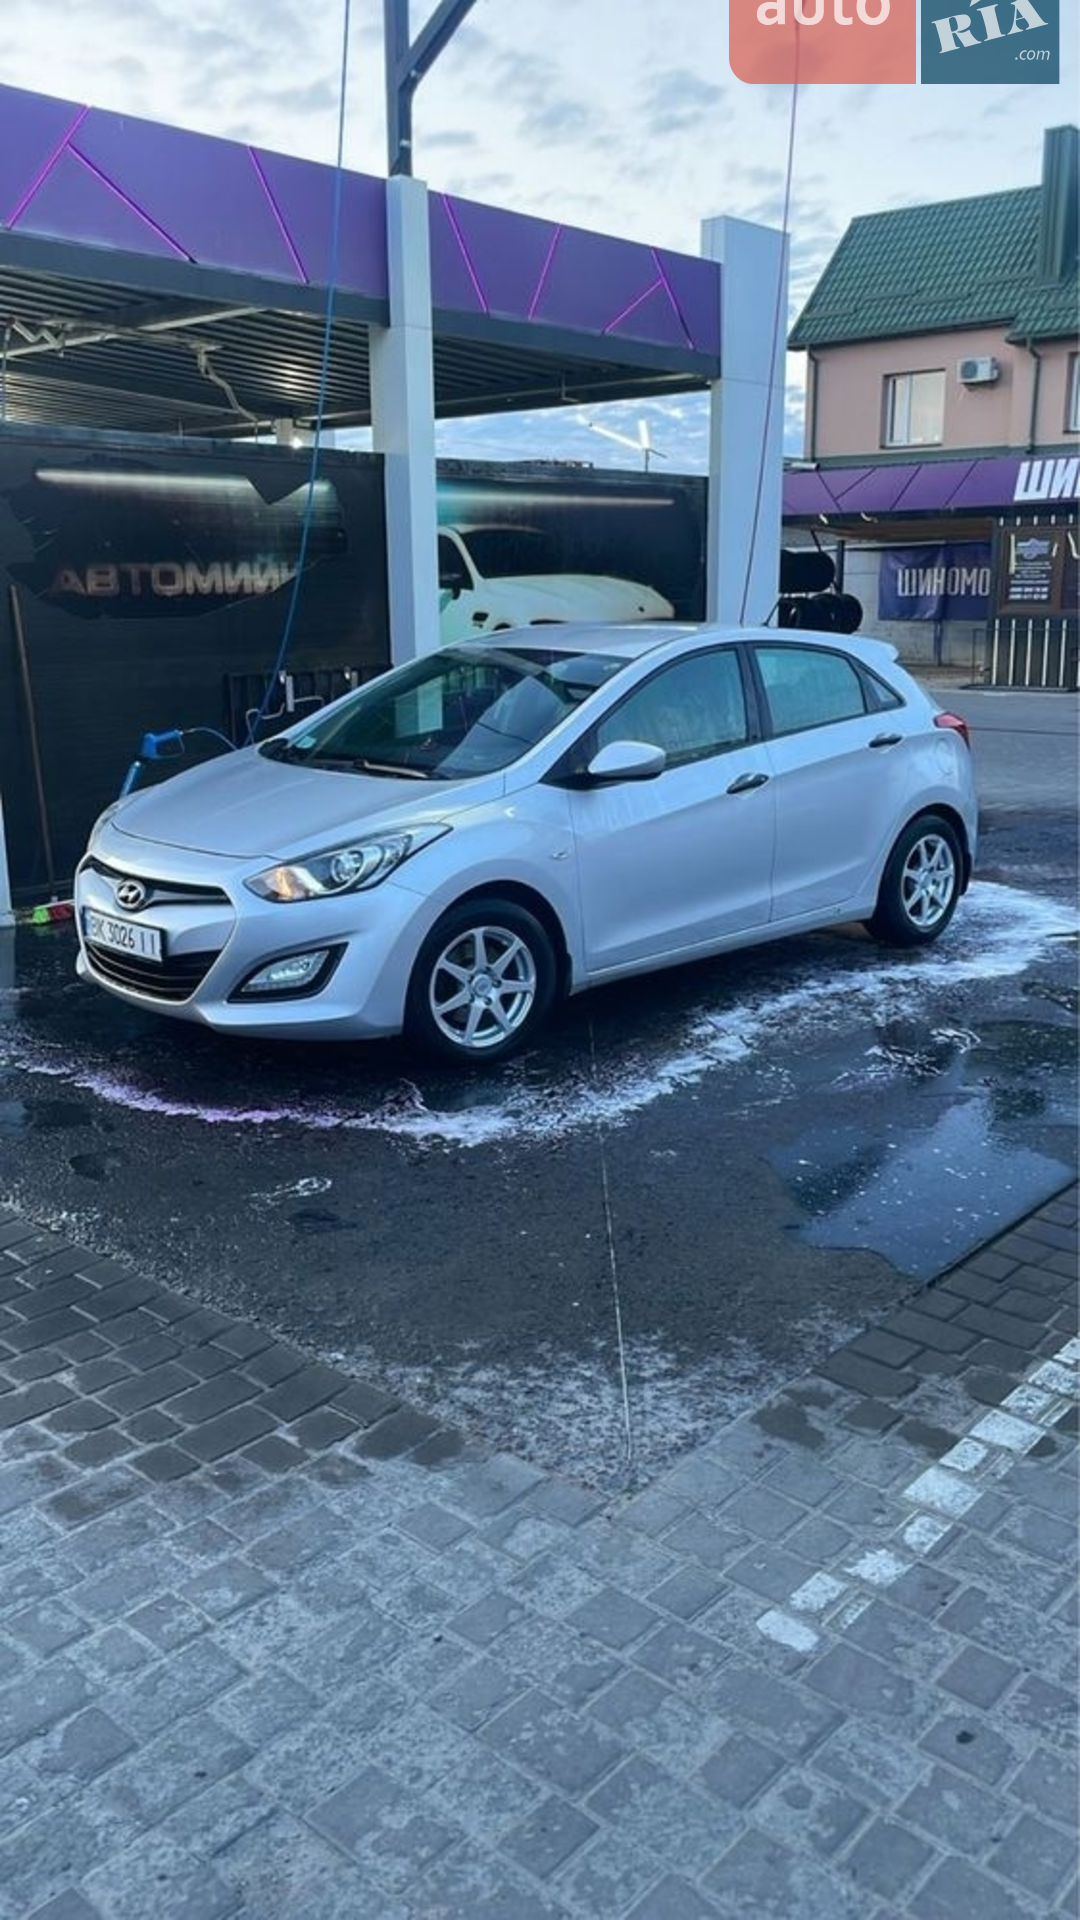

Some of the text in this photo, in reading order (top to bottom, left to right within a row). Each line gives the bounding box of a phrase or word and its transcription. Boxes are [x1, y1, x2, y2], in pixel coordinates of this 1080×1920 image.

[1013, 457, 1080, 501] ШИ
[897, 567, 991, 597] ШИНОМО
[107, 920, 135, 950] 3026
